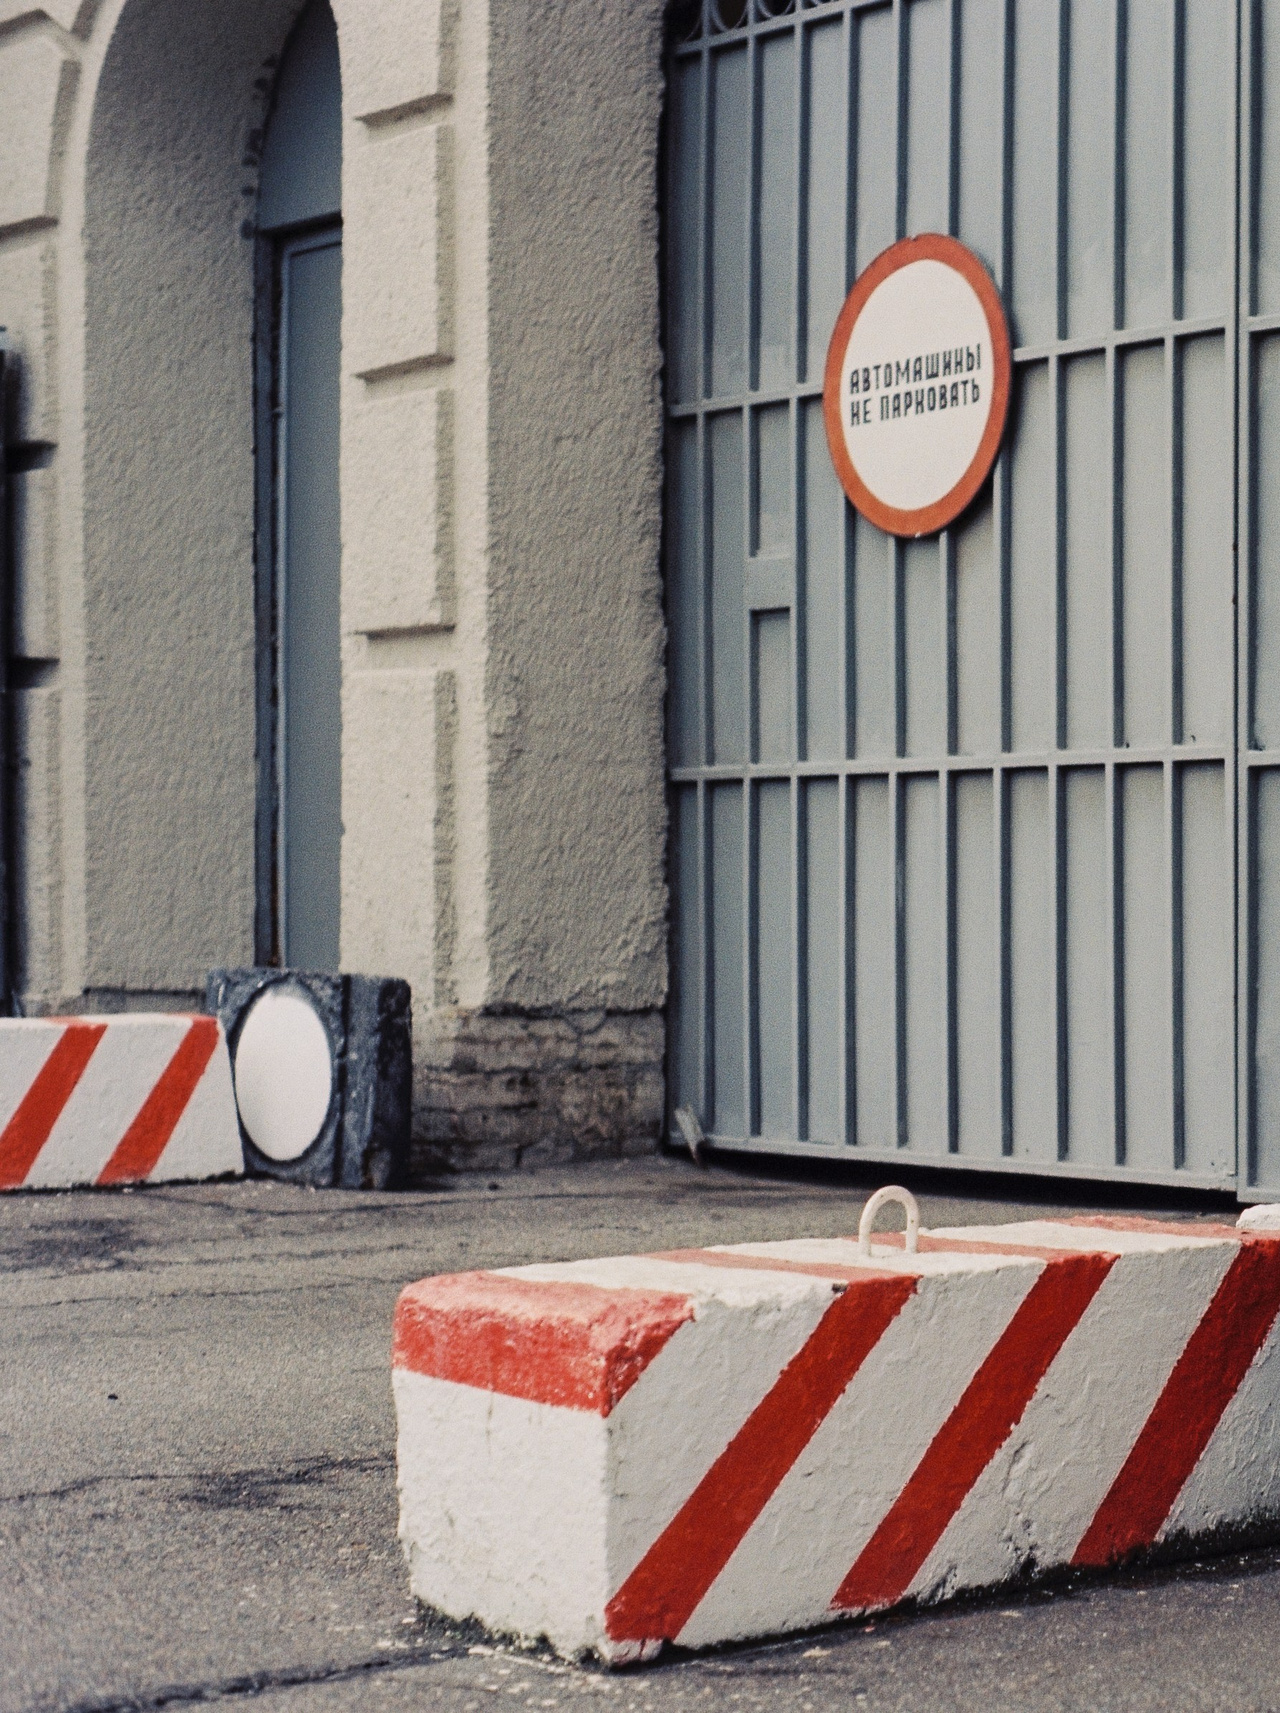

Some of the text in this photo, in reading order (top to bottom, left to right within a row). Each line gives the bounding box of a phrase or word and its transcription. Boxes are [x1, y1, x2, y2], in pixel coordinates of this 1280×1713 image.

[850, 343, 981, 394] АВТОМАШИНЫ
[850, 378, 980, 427] НЕ ПАРКОВАТЬ
